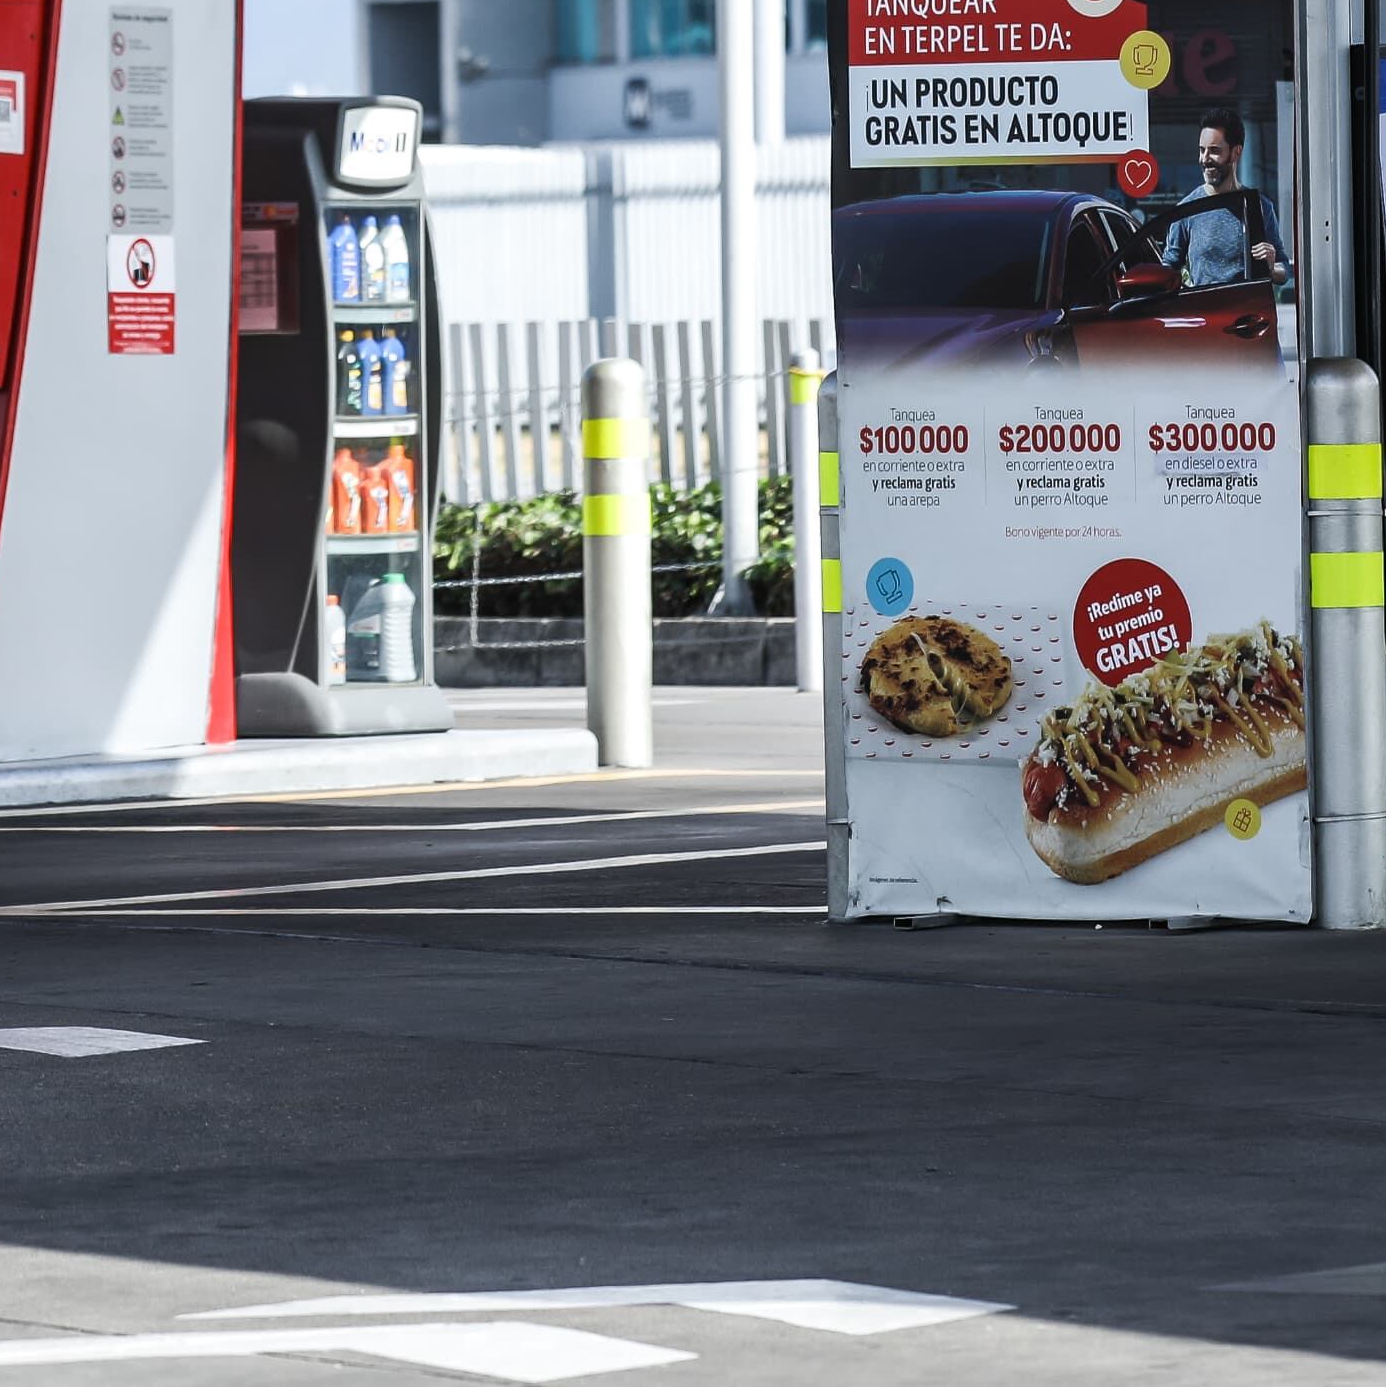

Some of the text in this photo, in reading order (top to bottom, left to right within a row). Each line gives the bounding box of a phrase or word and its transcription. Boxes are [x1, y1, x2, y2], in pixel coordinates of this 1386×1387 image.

[865, 23, 1072, 54] EN TERPEL TE DA:
[866, 75, 1059, 113] ¡UN PRODUCTO
[866, 111, 1134, 147] GRATIS EN ALTOQUE!
[890, 408, 935, 423] Tanquea
[1035, 407, 1083, 422] Tanquea
[1186, 405, 1235, 420] Tanquea
[863, 459, 965, 472] en corriente o extra
[1006, 458, 1114, 471] en corriente o extra
[1166, 456, 1257, 470] en diesel o extra
[873, 475, 955, 492] y reclama gratis
[1017, 474, 1105, 491] y reclama gratis
[1167, 473, 1258, 490] y reclama gratis
[888, 496, 940, 508] una arepa
[1015, 493, 1108, 508] un perro Altoque
[1164, 492, 1261, 507] un perro Altoque
[1005, 526, 1122, 540] Bono vigente por 24 horas.
[1088, 585, 1162, 622] ¡Redime ya
[1098, 606, 1163, 640] tu premio
[1097, 624, 1180, 672] GRATIS!
